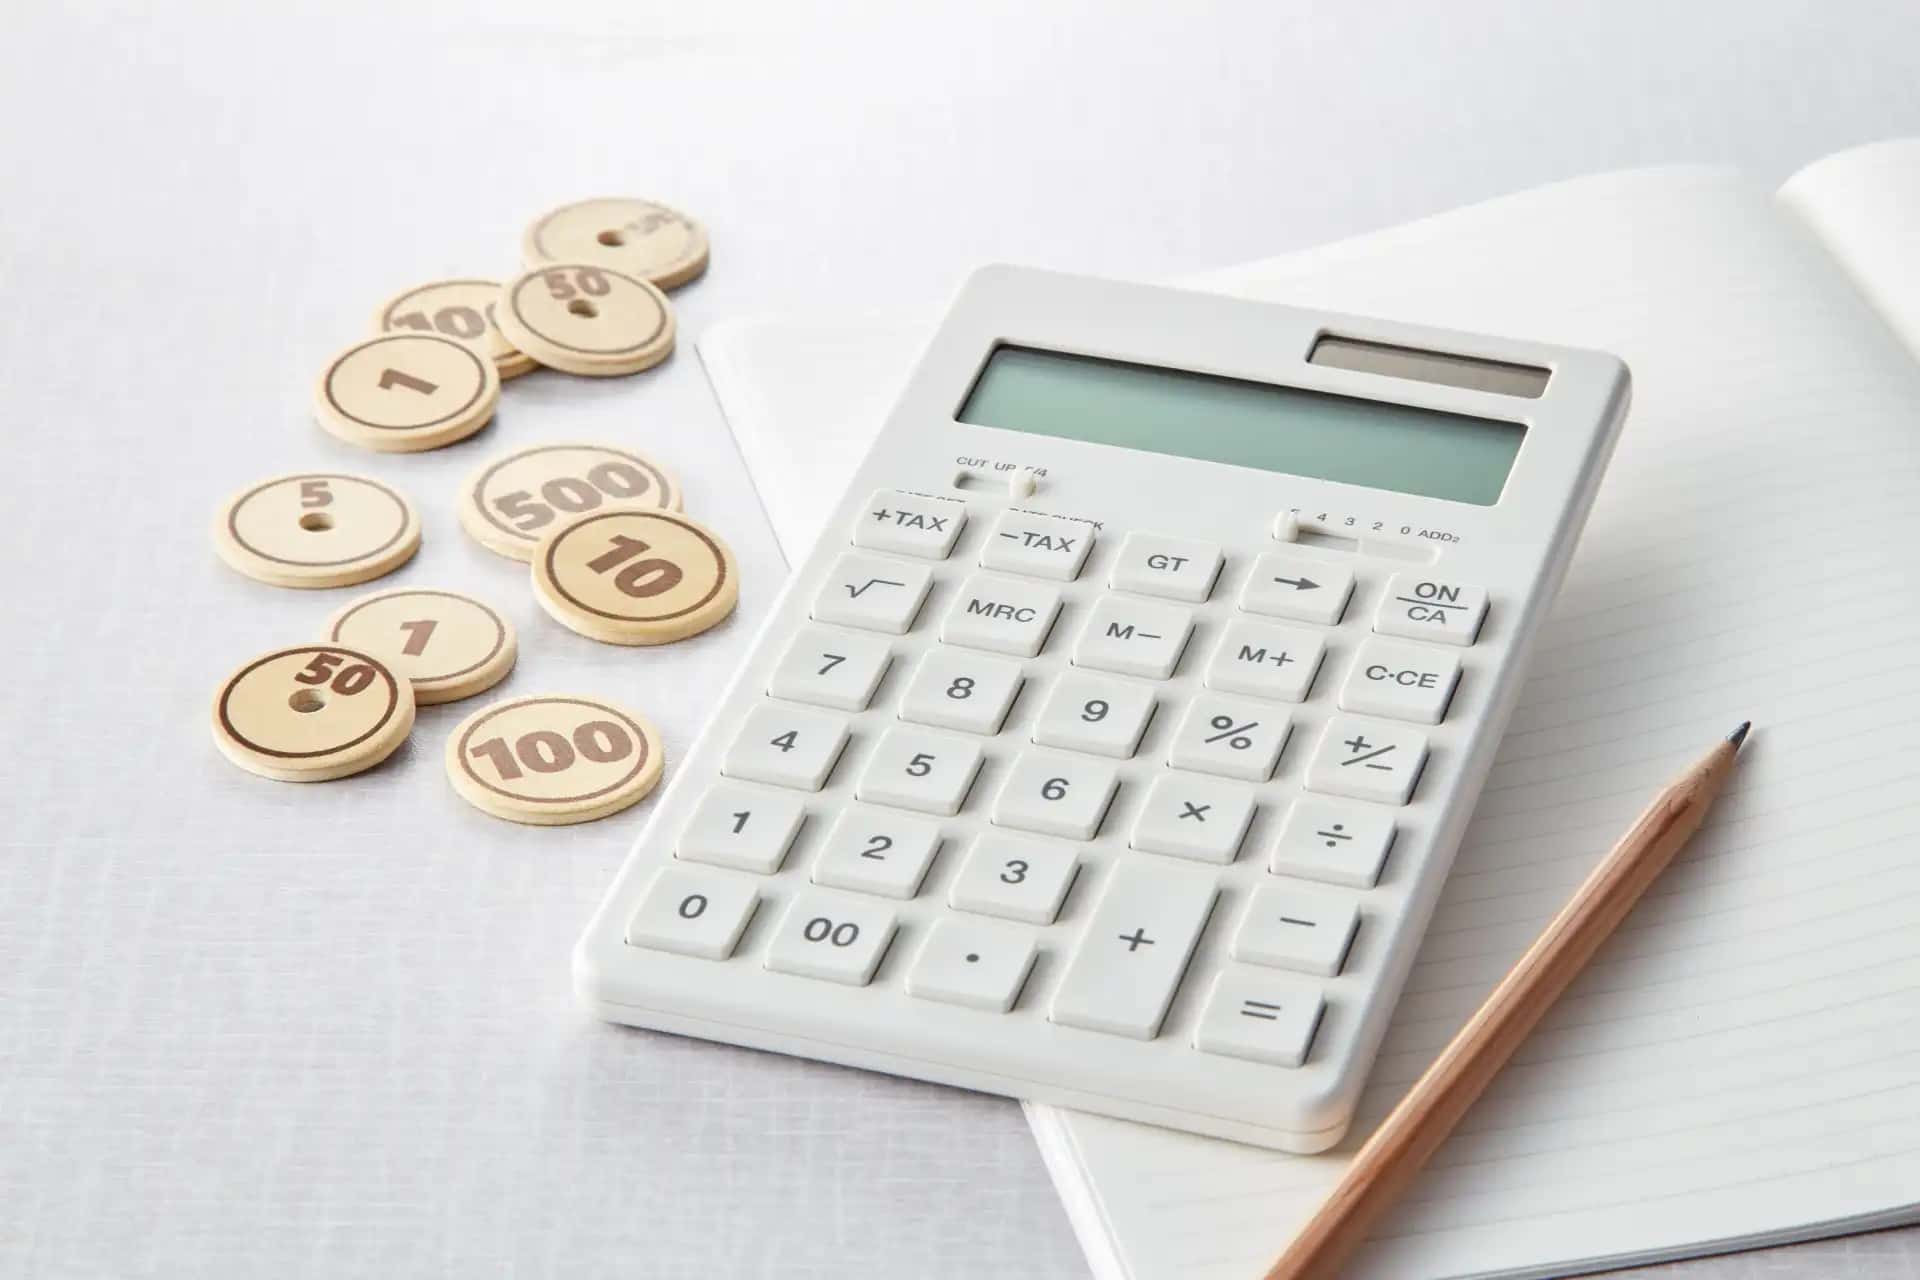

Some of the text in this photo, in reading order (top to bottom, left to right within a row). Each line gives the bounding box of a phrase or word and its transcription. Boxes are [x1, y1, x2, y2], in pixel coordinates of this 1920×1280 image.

[544, 269, 611, 300] 50
[392, 301, 498, 340] 10
[377, 368, 440, 396] 1
[956, 456, 988, 468] CUT
[994, 462, 1017, 472] UP
[300, 481, 334, 508] 5
[492, 462, 650, 531] 500
[1316, 512, 1328, 522] 4
[1344, 517, 1356, 526] 3
[1372, 521, 1384, 531] 2
[585, 534, 684, 598] 10
[1147, 554, 1189, 572] GT
[1415, 582, 1461, 602] ON
[967, 598, 1036, 623] MRC
[1407, 606, 1447, 625] CA
[399, 620, 438, 656] 1
[294, 653, 377, 696] 50
[818, 653, 847, 676] 7
[946, 677, 976, 700] 8
[1081, 699, 1109, 723] 9
[770, 730, 799, 753] 4
[1204, 715, 1259, 750] %
[469, 720, 633, 781] 100
[905, 754, 936, 777] 5
[1041, 777, 1070, 801] 6
[732, 811, 751, 834] 1
[861, 836, 893, 860] 2
[999, 859, 1029, 884] 3
[678, 894, 708, 919] 0
[803, 917, 860, 947] 00
